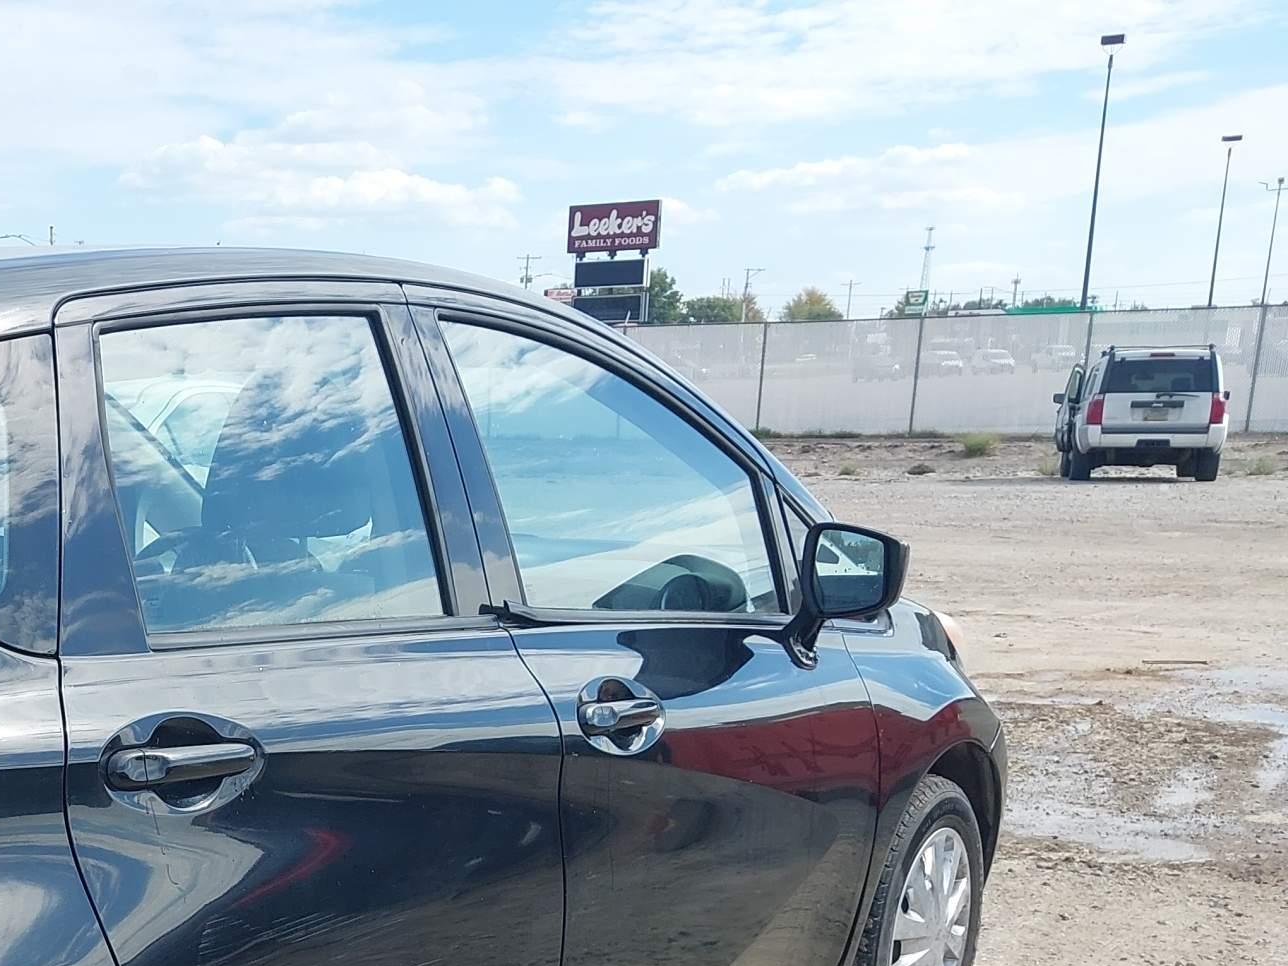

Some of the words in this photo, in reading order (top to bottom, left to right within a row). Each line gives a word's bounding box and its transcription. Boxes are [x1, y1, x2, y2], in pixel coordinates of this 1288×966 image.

[571, 209, 655, 237] Leeker's
[574, 238, 613, 248] FAMILY
[614, 236, 649, 247] FOODS
